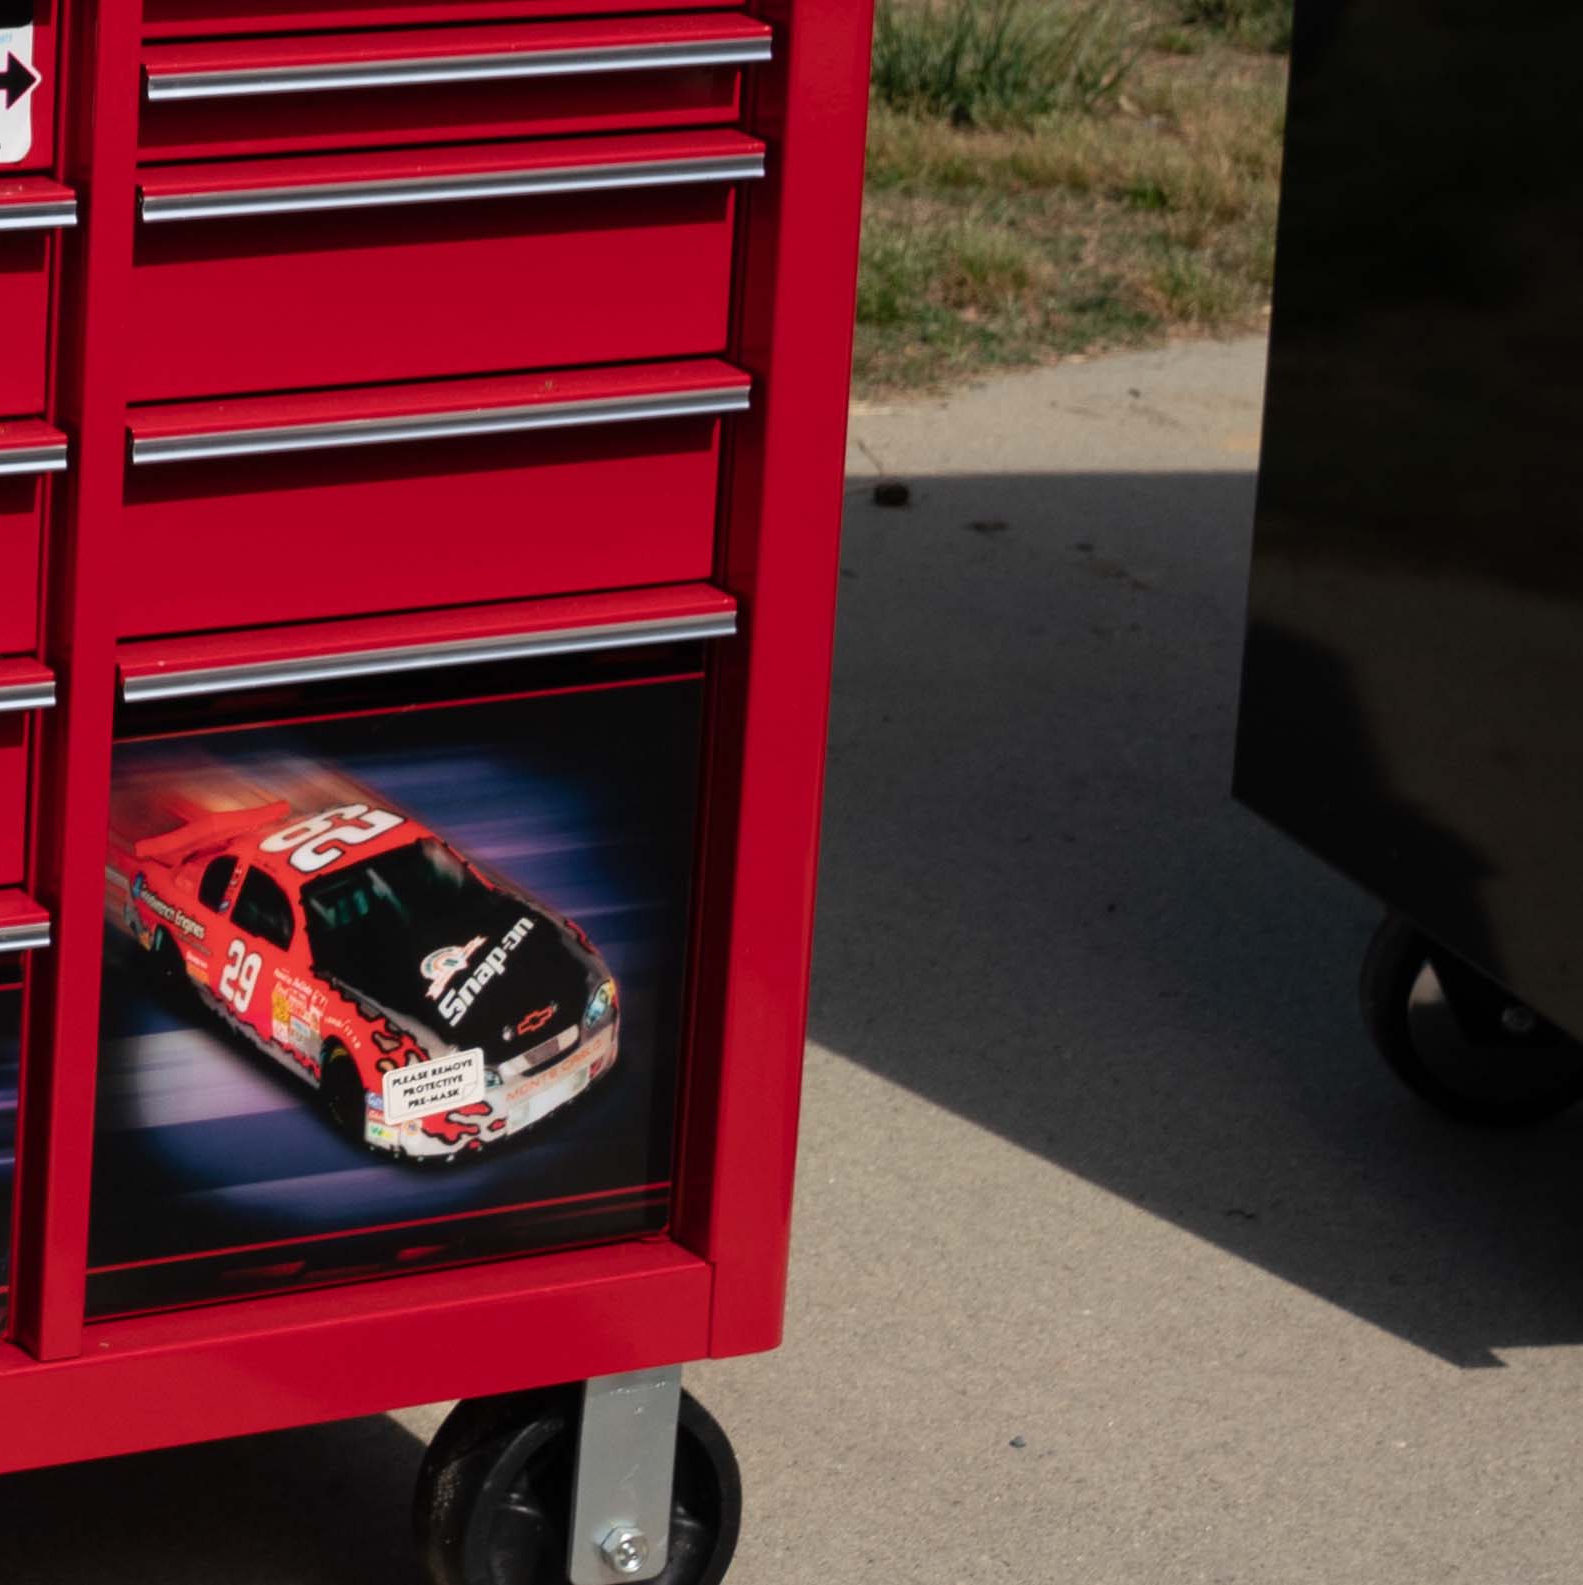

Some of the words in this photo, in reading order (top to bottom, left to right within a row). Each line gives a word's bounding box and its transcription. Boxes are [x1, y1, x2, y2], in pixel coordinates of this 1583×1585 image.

[218, 938, 263, 1014] 29
[437, 915, 536, 1028] Snap-on
[391, 1070, 429, 1088] PLEASE
[430, 1058, 474, 1078] REMOVE
[402, 1073, 465, 1098] PROTECTIVE
[407, 1088, 461, 1110] PRE-MASK
